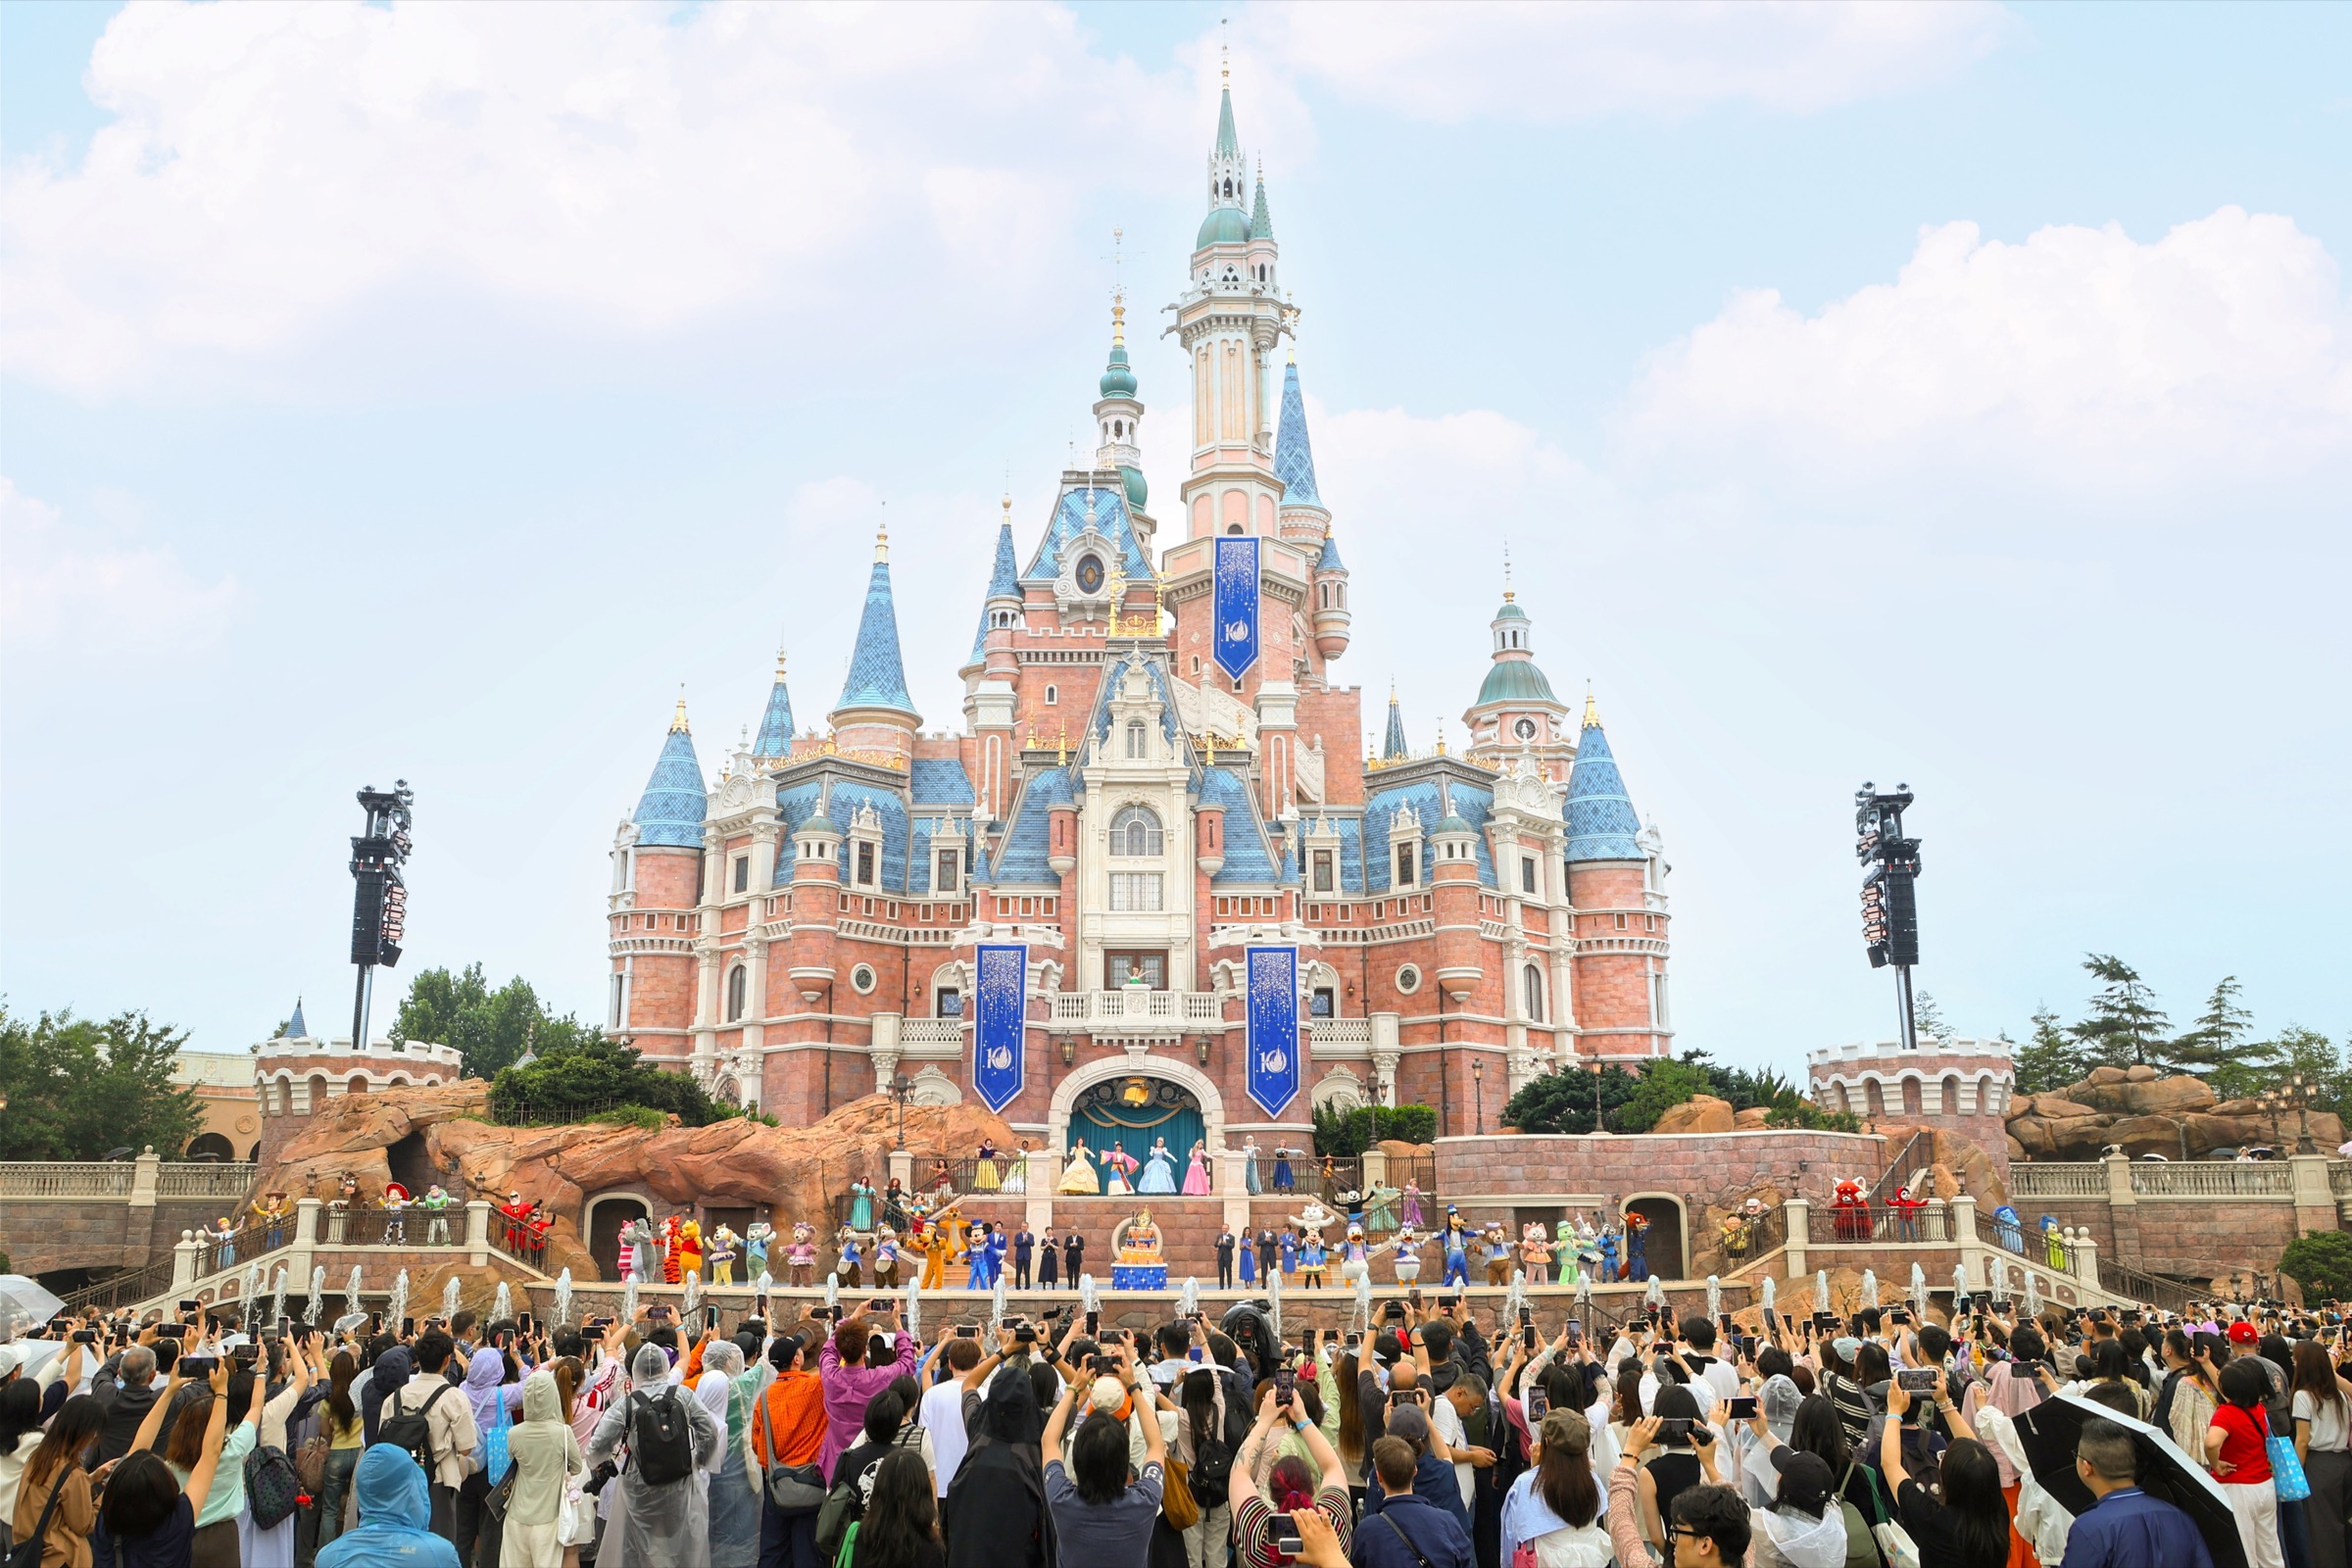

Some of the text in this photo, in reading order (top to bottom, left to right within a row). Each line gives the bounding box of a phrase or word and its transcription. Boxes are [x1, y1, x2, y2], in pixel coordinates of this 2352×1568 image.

[1224, 619, 1249, 642] 10
[985, 1046, 1012, 1070] 10
[1259, 1048, 1288, 1074] 10
